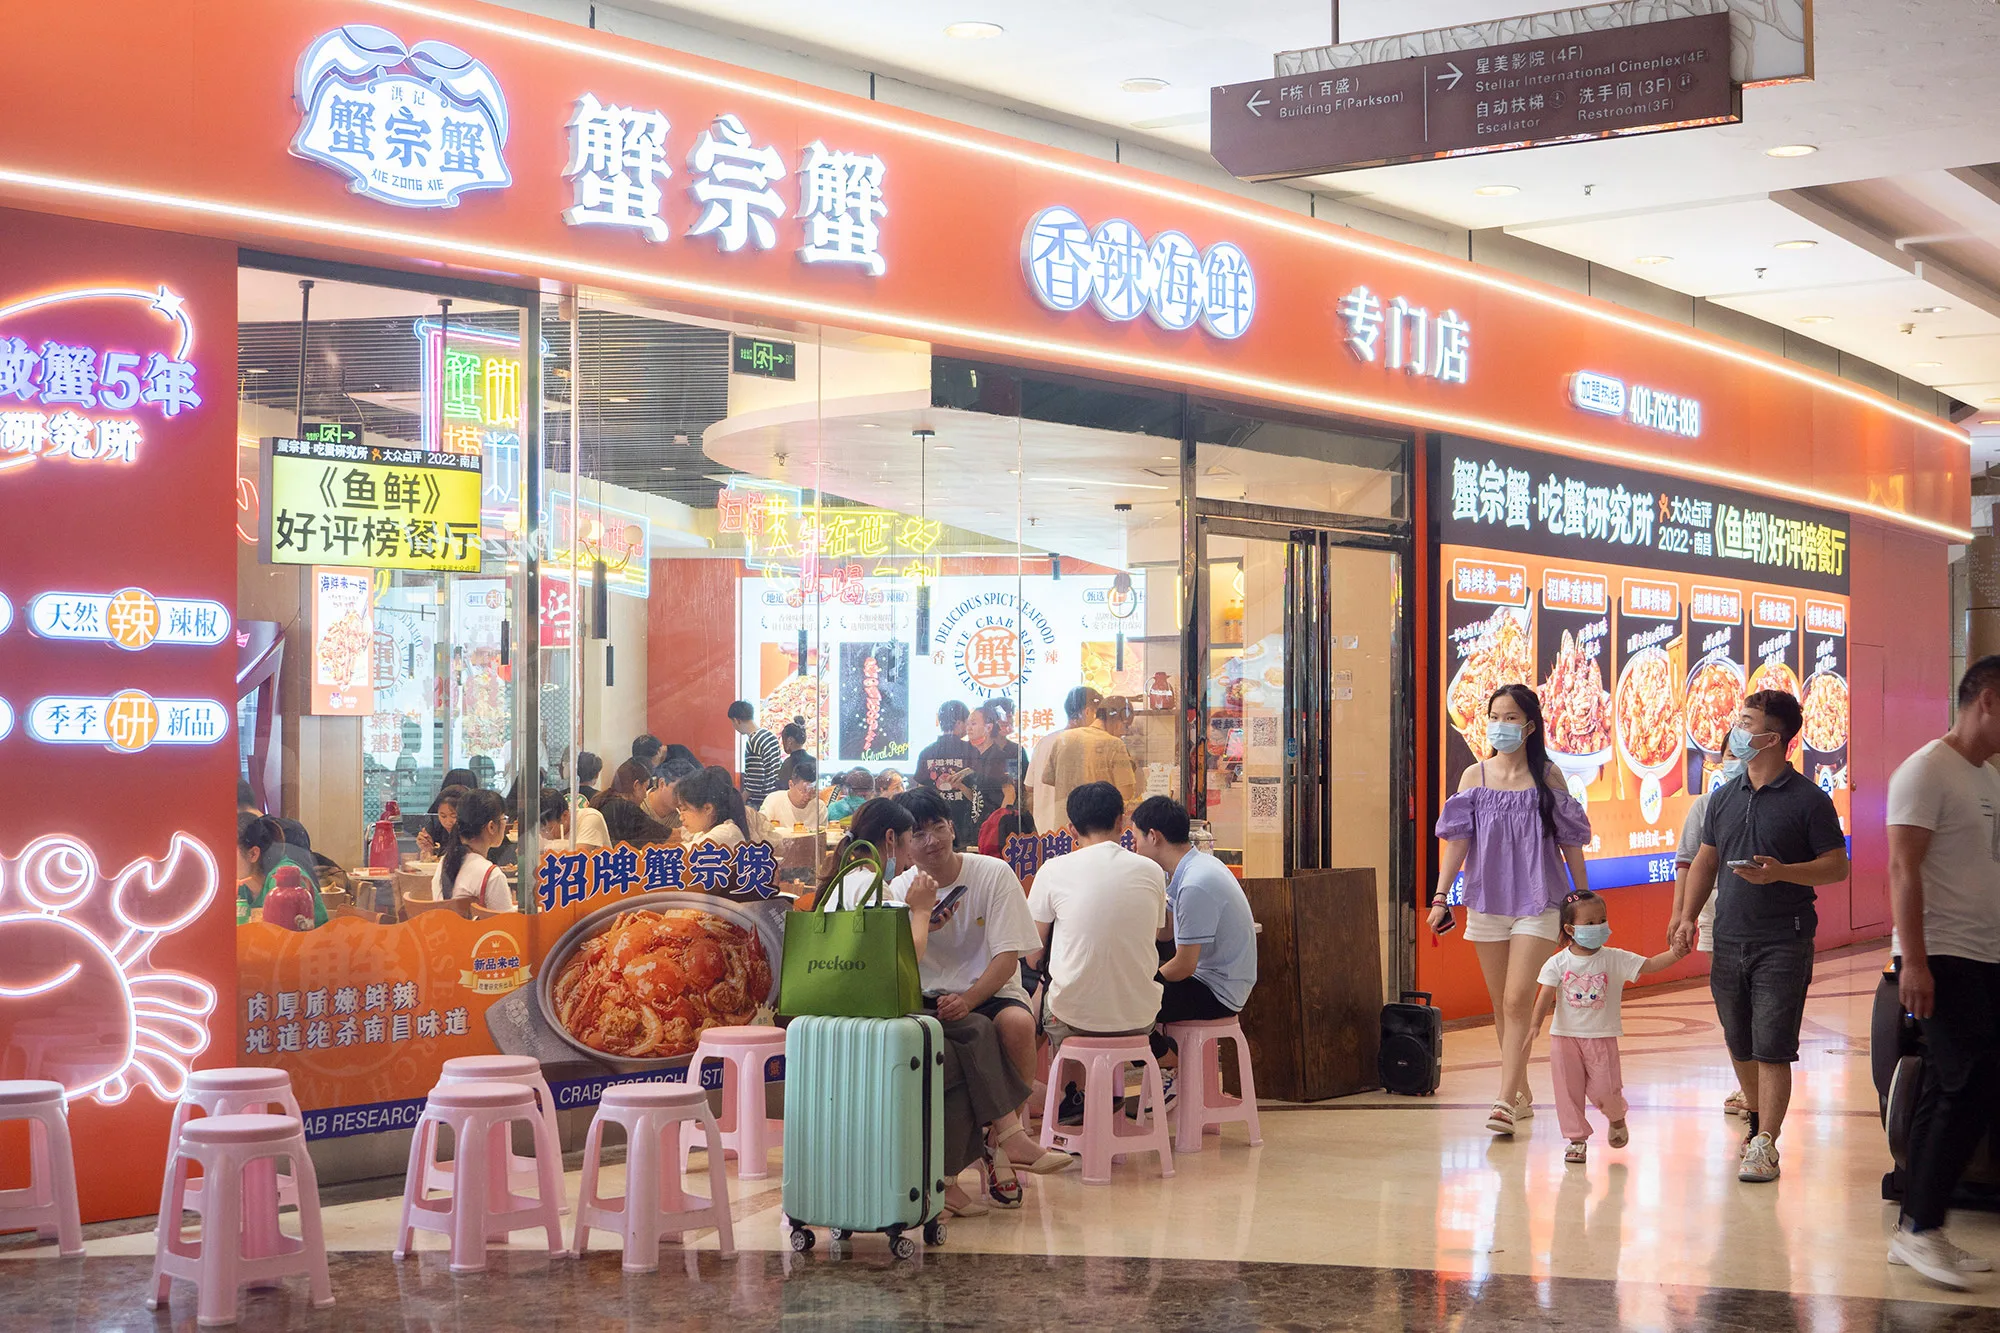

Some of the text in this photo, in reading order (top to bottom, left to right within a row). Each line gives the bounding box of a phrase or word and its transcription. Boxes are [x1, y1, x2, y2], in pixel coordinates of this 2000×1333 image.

[1475, 45, 1584, 75] 星美影院 (4F)
[1475, 78, 1521, 93] Stellar
[1524, 63, 1615, 86] International
[391, 85, 425, 106] 洪记
[1279, 92, 1405, 118] Building F(Parkson)
[1476, 78, 1673, 118] 自动扶梯 洗手间 (3F)
[1477, 98, 1674, 134] Escalator Restroom(3F)
[328, 95, 485, 179] 蟹宗蟹
[370, 167, 445, 191] XIE ZONG XIE
[560, 91, 888, 277] 蟹宗蟹
[1032, 222, 1250, 337] 香辣海鲜
[1336, 284, 1470, 384] 专门店
[0, 411, 143, 462] 研究所
[277, 438, 480, 469] 蟹宗蟹·吃蟹研究所 大众点评 2022·南昌
[319, 466, 441, 515] 《鱼鲜》
[1451, 457, 1655, 547] 蟹宗蟹·吃蟹研究所
[1670, 496, 1713, 529] 大众点评
[275, 508, 478, 561] 好评榜餐厅
[1658, 525, 1713, 558] 2022·南昌
[1458, 567, 1523, 597] 海鲜来一铲
[1547, 577, 1604, 607] 招牌香辣蟹
[934, 596, 983, 644] DELICIOUS
[983, 592, 1015, 607] SPICY
[975, 615, 1014, 629] CRAB
[953, 630, 992, 699] INSTITUTE
[973, 633, 1021, 681] 蟹
[538, 842, 778, 912] 招牌蟹宗煲
[473, 956, 521, 972] 新品来啦
[807, 955, 866, 974] peekoo
[246, 979, 419, 1023] 肉厚质嫩鲜辣
[245, 1006, 471, 1055] 地道绝杀南昌味道
[559, 1082, 602, 1104] CRAB
